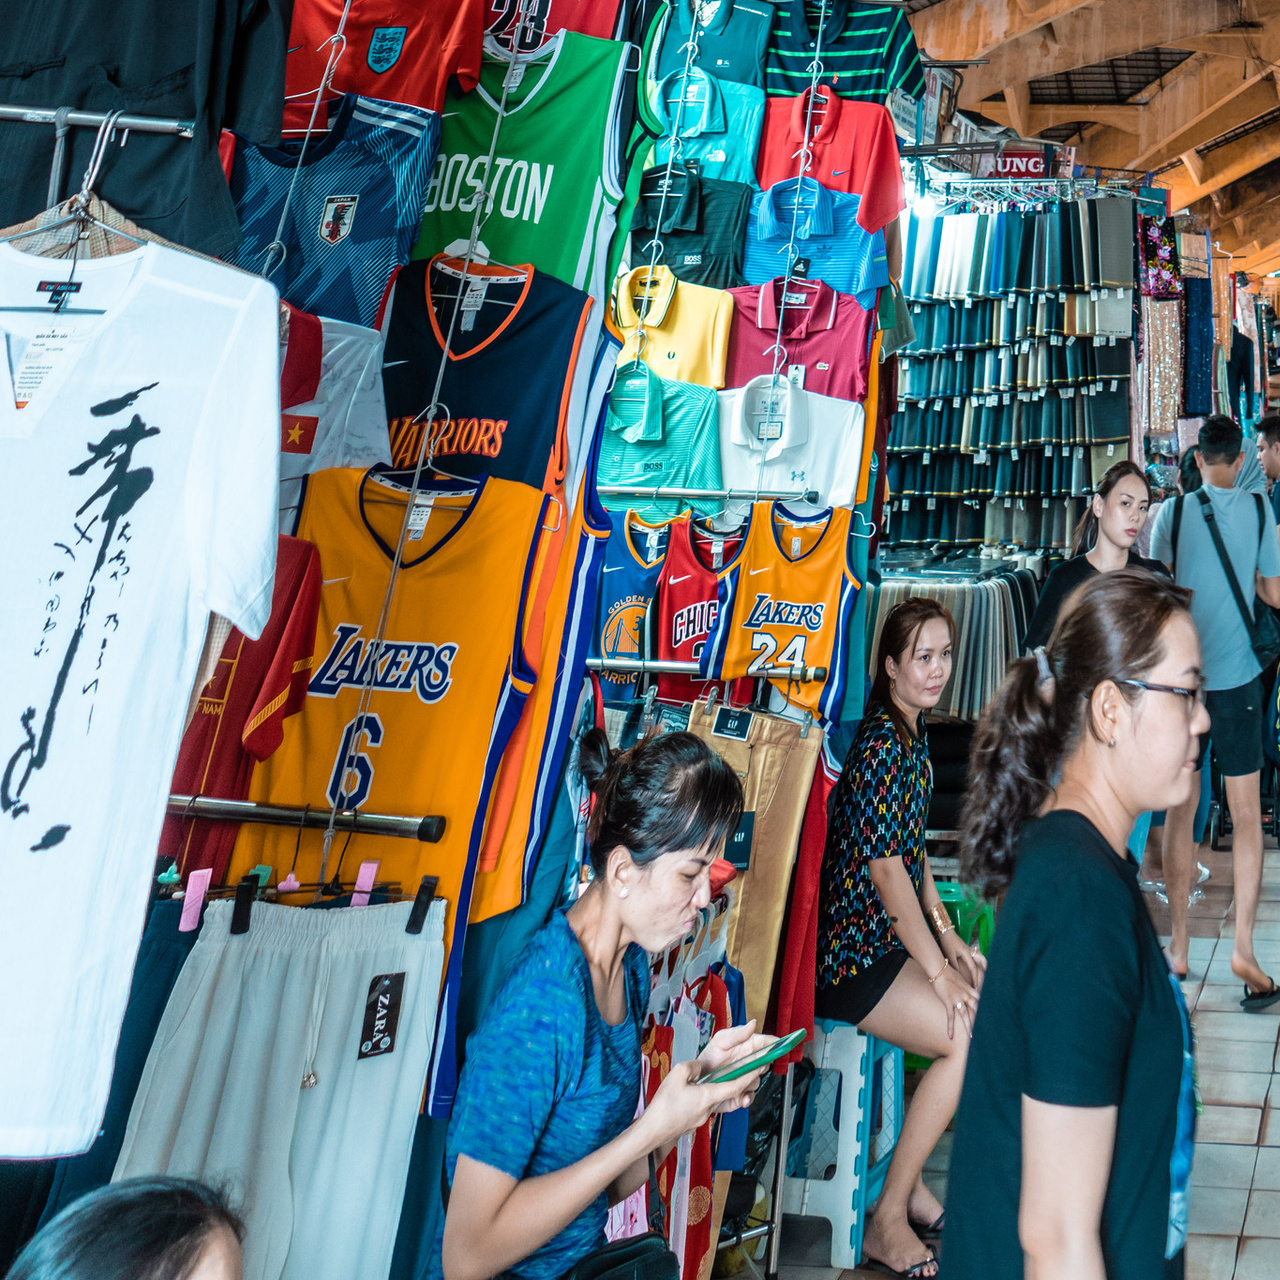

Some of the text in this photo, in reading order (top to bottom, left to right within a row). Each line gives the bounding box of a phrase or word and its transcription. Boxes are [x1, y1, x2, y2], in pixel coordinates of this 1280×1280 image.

[424, 153, 554, 224] BOSTON
[644, 462, 663, 470] BOSS
[608, 594, 644, 614] GOLDEN
[742, 593, 825, 632] LAKERS
[307, 622, 460, 704] LAKERS
[747, 632, 808, 676] 24
[325, 712, 384, 809] 6
